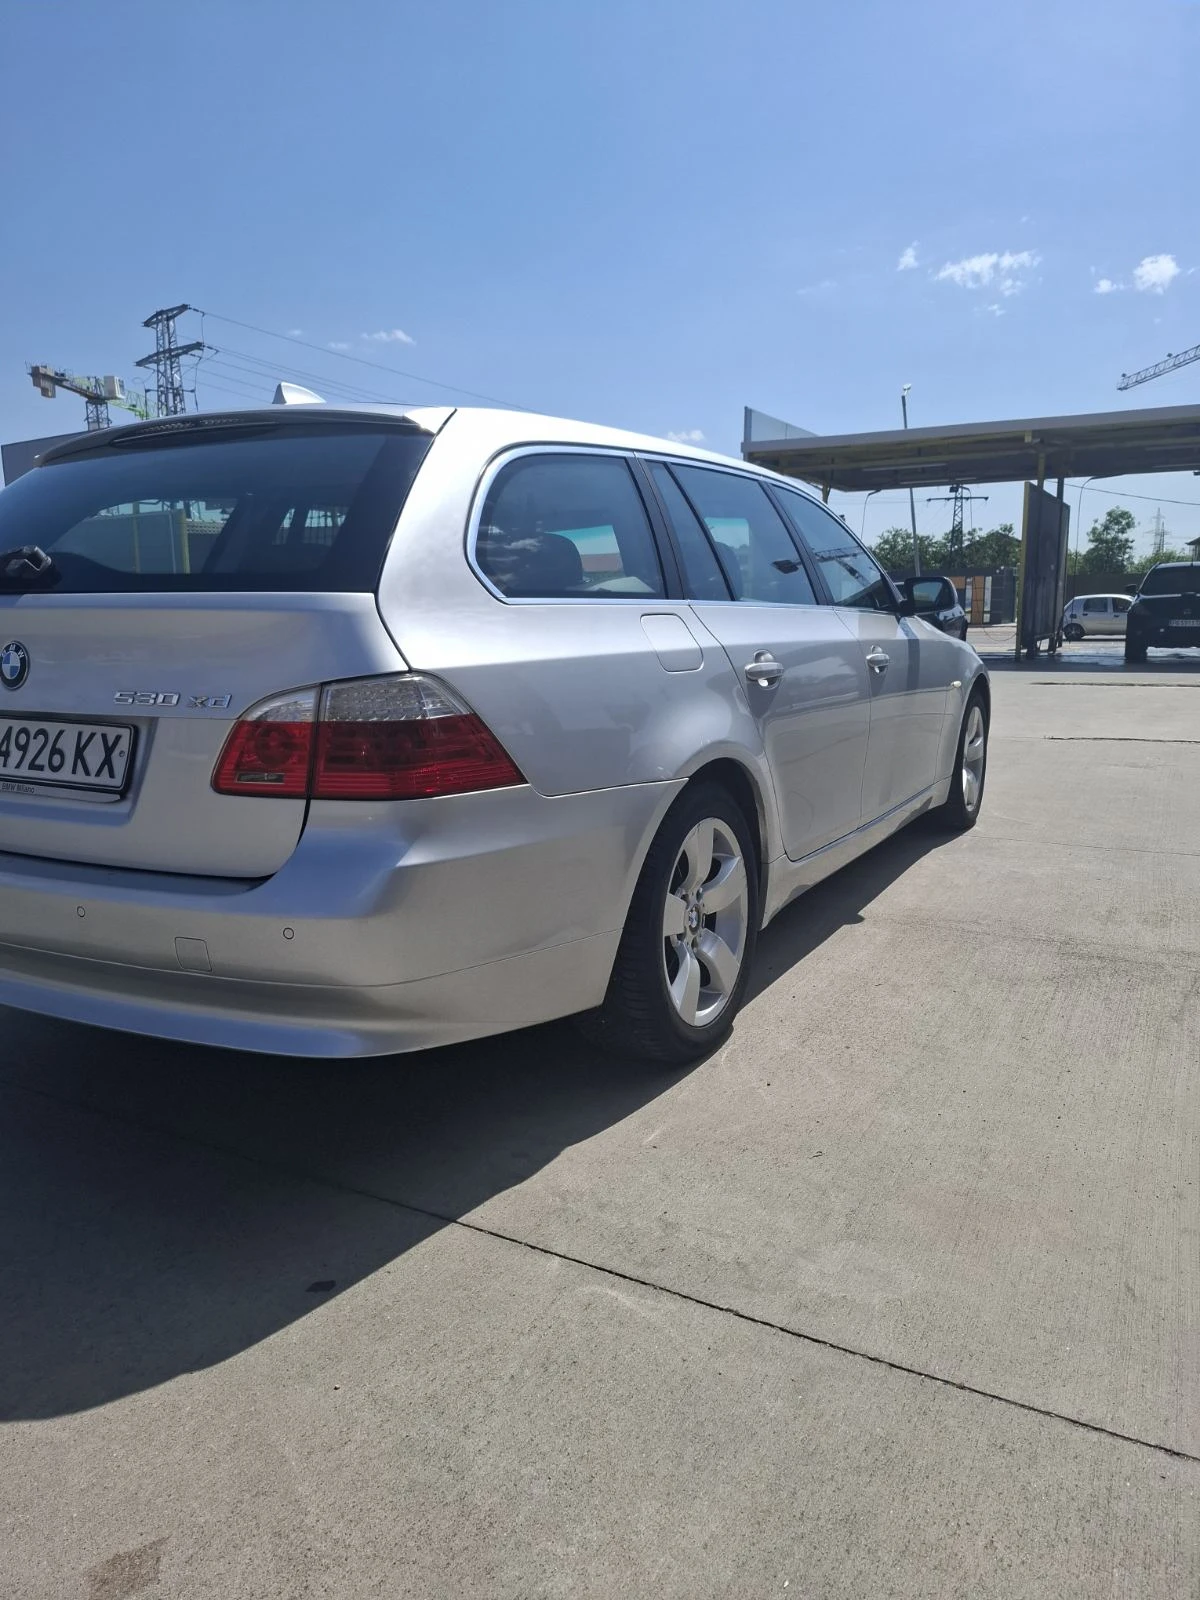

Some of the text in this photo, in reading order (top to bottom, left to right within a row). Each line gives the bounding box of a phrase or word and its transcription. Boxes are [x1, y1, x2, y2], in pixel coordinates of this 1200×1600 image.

[114, 691, 232, 709] 530 xd
[71, 730, 122, 779] KX
[2, 783, 35, 794] BMW Milano
